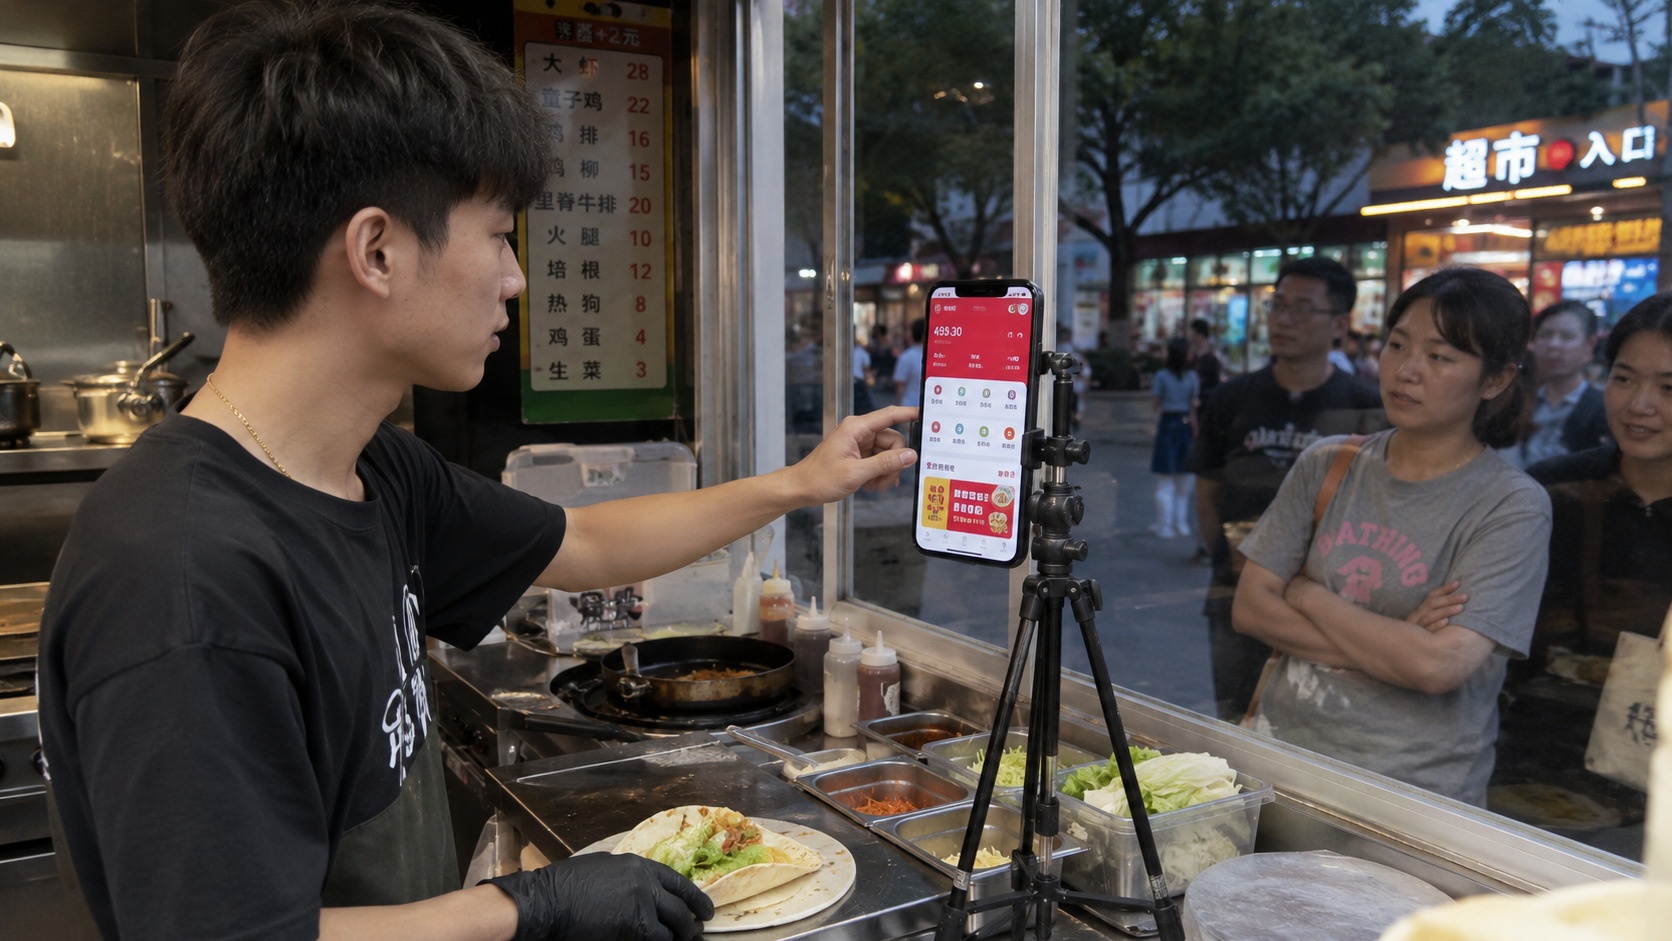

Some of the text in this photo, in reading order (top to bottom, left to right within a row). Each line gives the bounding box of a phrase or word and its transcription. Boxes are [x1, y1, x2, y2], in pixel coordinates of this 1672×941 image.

[543, 53, 649, 80] 大虾 28
[542, 88, 650, 114] 童子鸡 22
[628, 130, 650, 148] 16
[1442, 125, 1656, 191] 超市 入口
[629, 164, 650, 182] 15
[535, 191, 651, 214] 里脊牛排 20
[547, 225, 651, 247] 火腿 10
[547, 259, 652, 280] 培根 12
[547, 293, 646, 313] 热狗 8
[548, 327, 646, 347] 鸡蛋 4
[548, 361, 646, 381] 生菜 3
